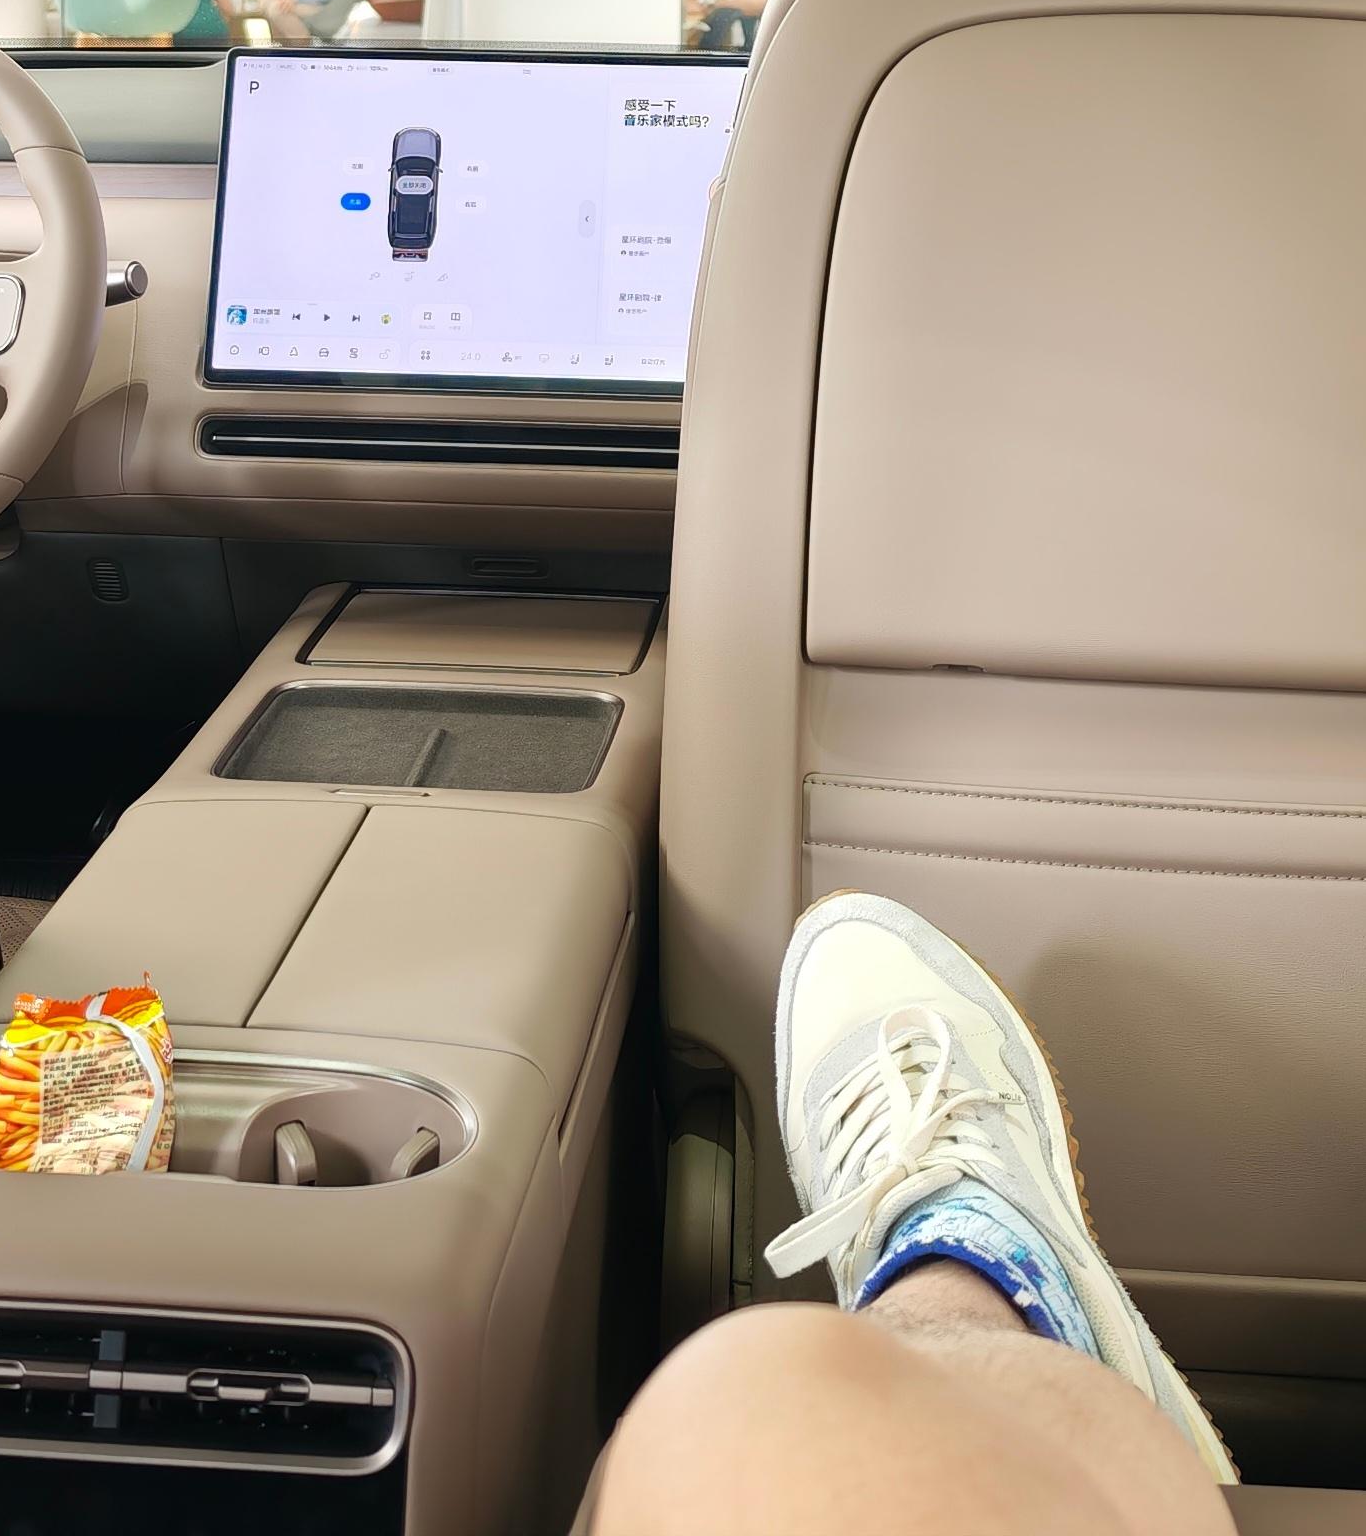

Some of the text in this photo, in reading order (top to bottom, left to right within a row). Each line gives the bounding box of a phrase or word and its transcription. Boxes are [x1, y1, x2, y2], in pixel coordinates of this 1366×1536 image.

[249, 81, 260, 94] P
[624, 99, 677, 112] 感受一下
